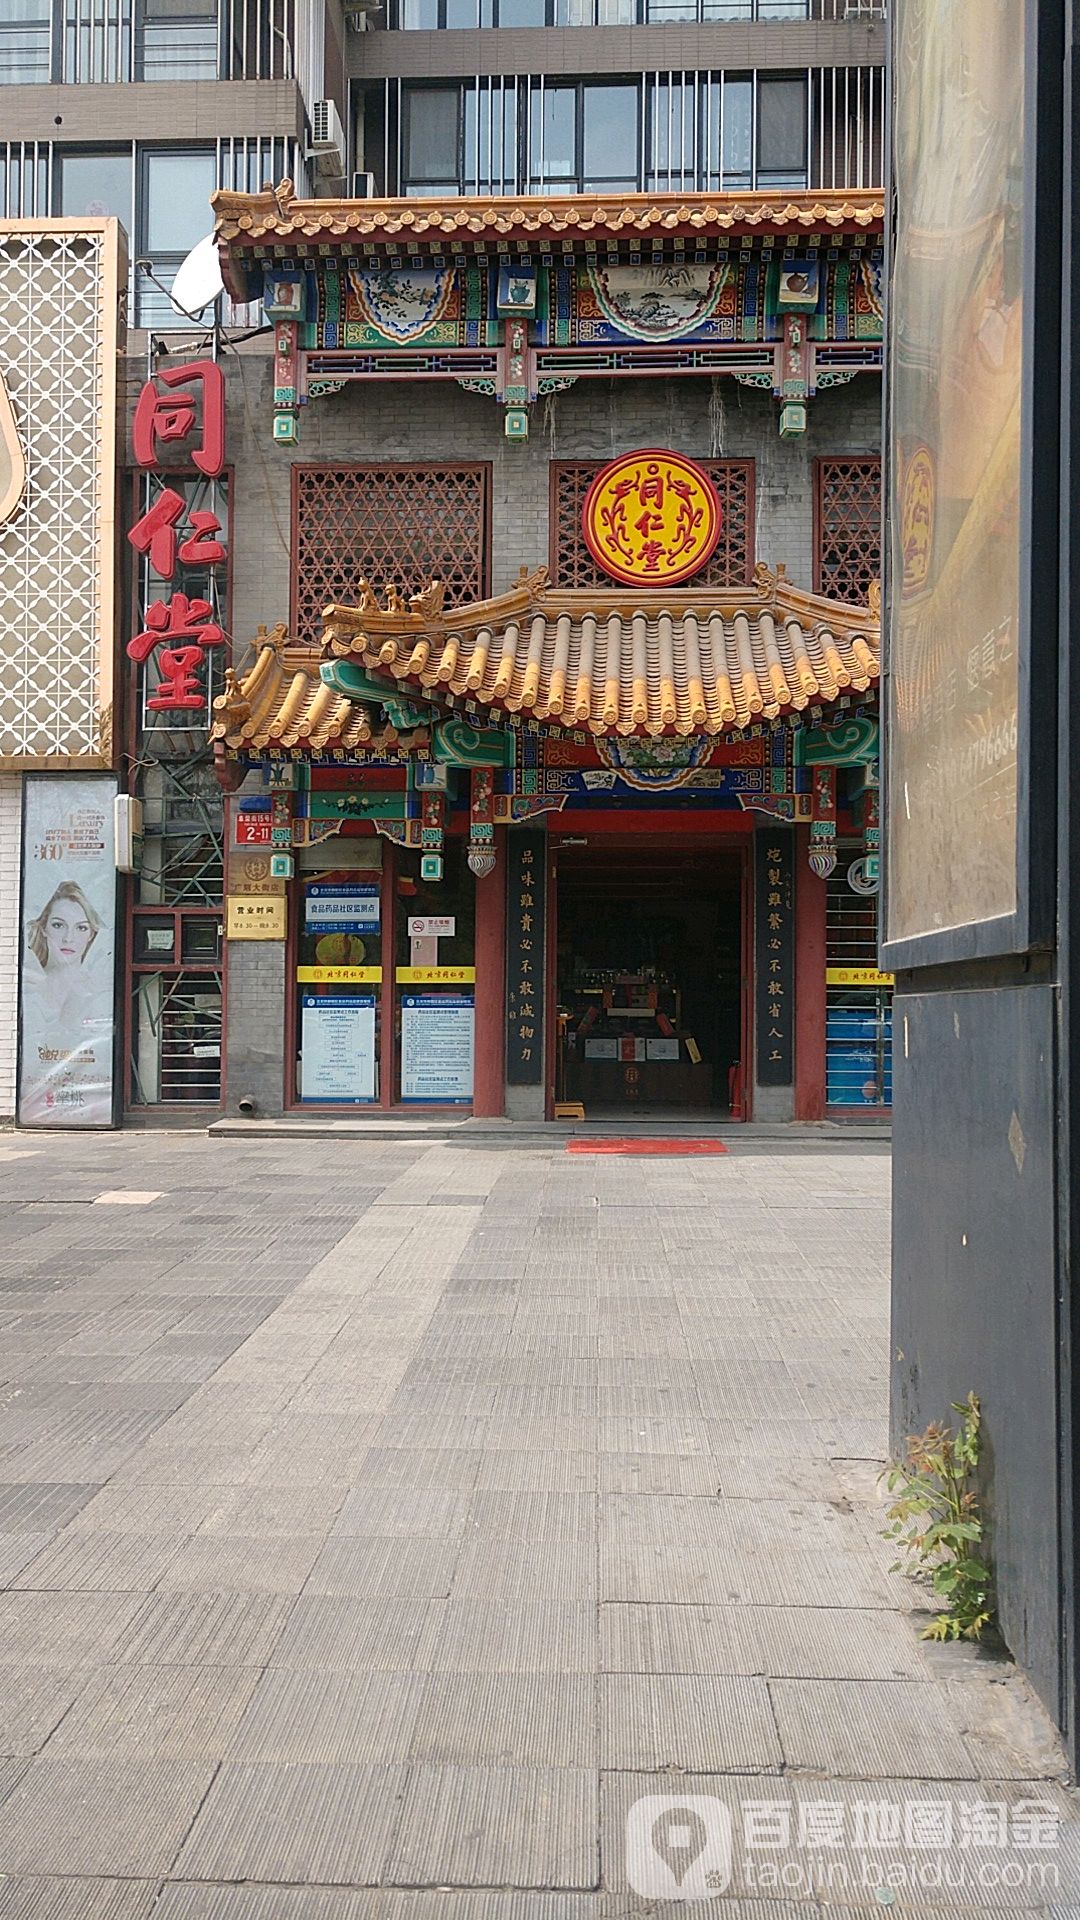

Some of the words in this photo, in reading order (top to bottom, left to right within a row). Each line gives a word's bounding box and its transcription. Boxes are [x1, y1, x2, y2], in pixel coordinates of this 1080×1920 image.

[634, 475, 666, 573] 同仁堂
[127, 360, 226, 710] 同仁堂
[246, 826, 269, 841] 2-11
[236, 906, 275, 915] 营业时间
[311, 904, 375, 914] 食品药品社区监测点
[326, 970, 366, 980] 北京同仁堂
[427, 971, 466, 980] 北京同仁堂
